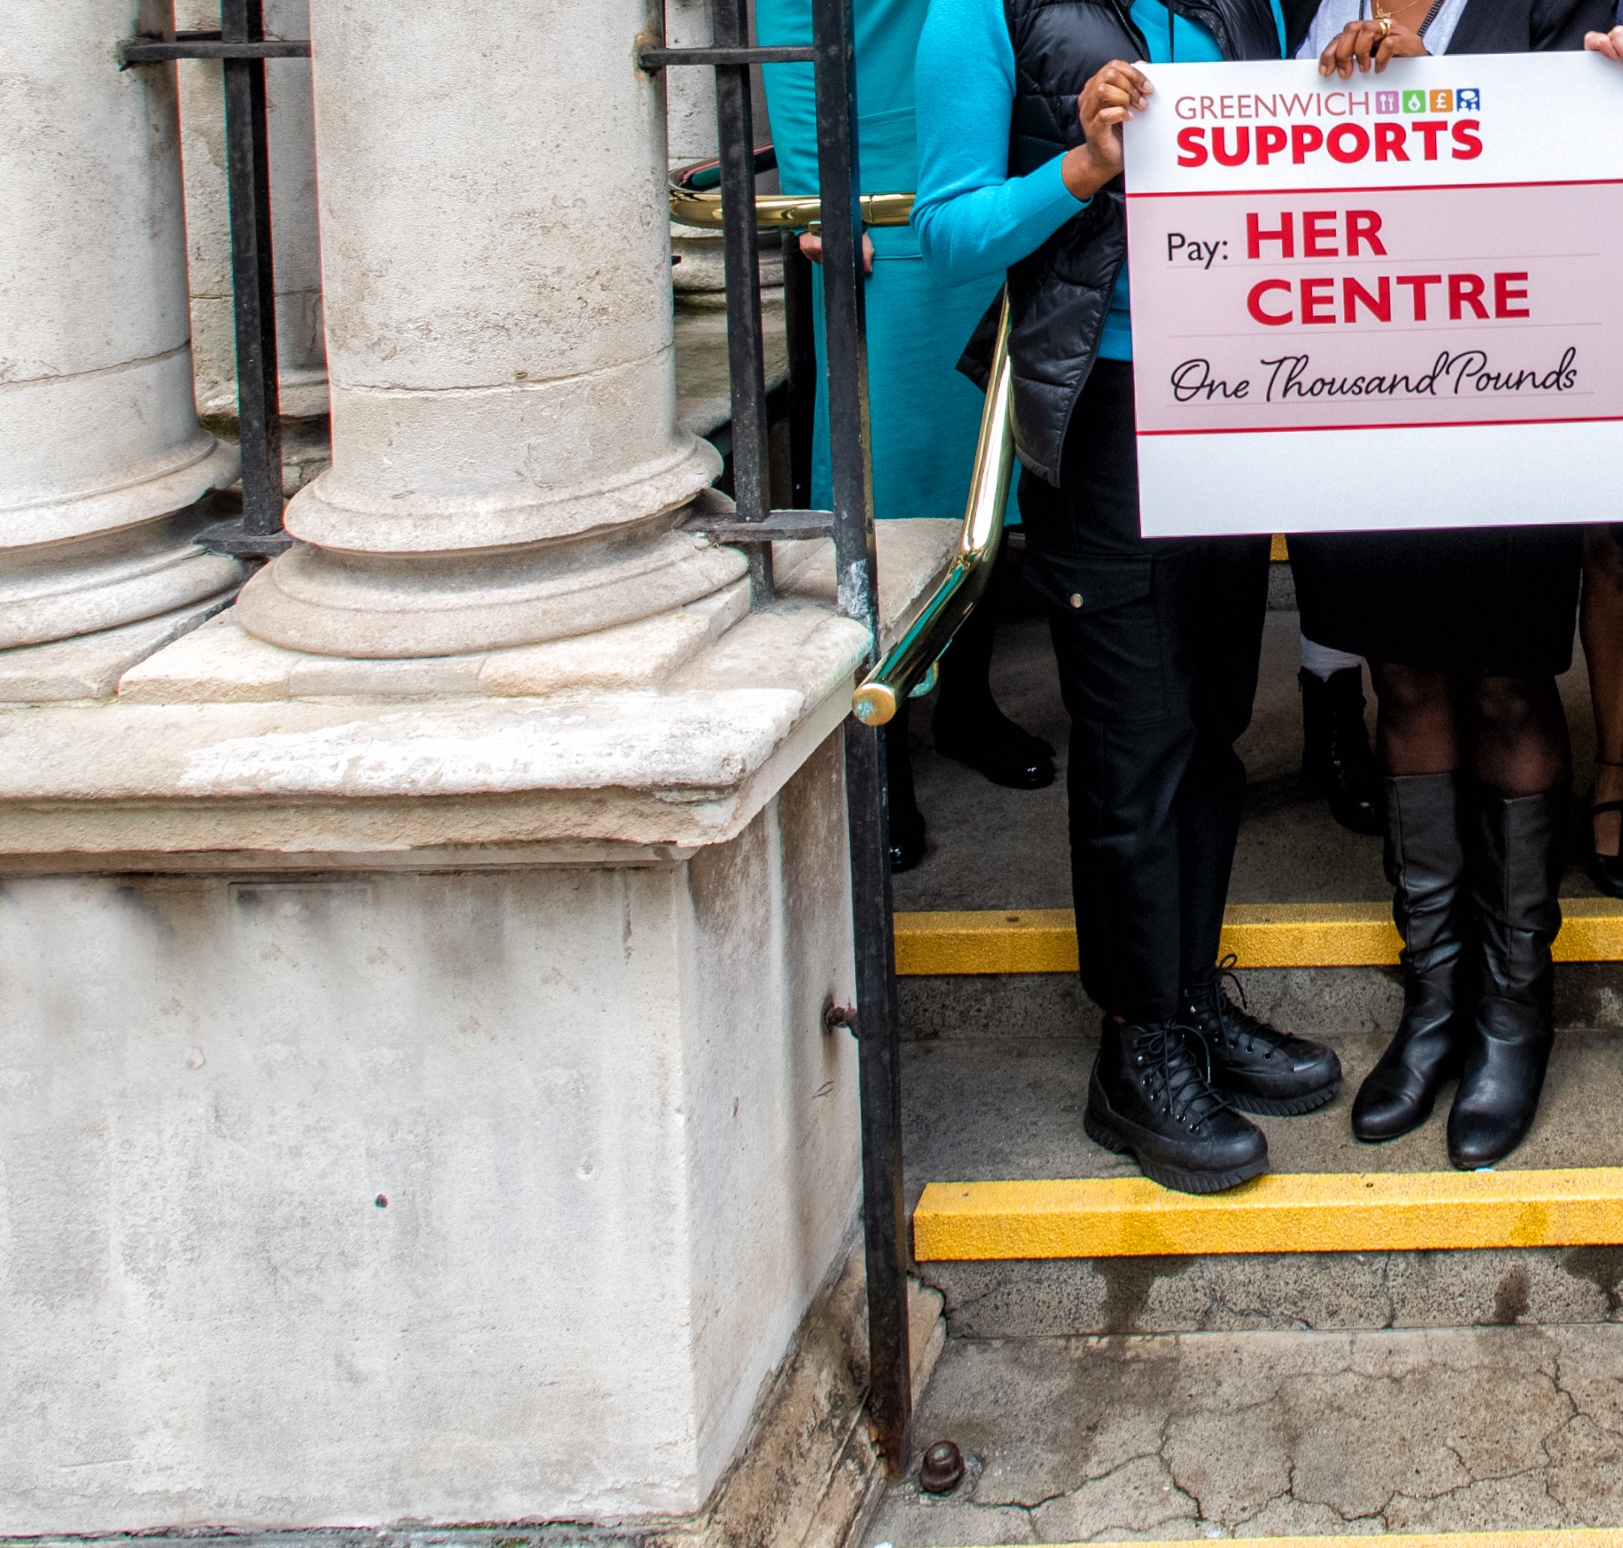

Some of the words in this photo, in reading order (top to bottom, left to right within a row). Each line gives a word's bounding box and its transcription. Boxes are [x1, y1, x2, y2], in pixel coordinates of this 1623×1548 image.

[1174, 91, 1370, 120] GREENWICH
[1176, 119, 1483, 168] SUPPORTS
[1166, 232, 1229, 270] Pay:
[1245, 209, 1388, 260] HER
[1246, 271, 1531, 327] CENTRE
[1169, 357, 1250, 403] One
[1260, 348, 1450, 403] Thousand
[1444, 346, 1578, 396] Pounds
